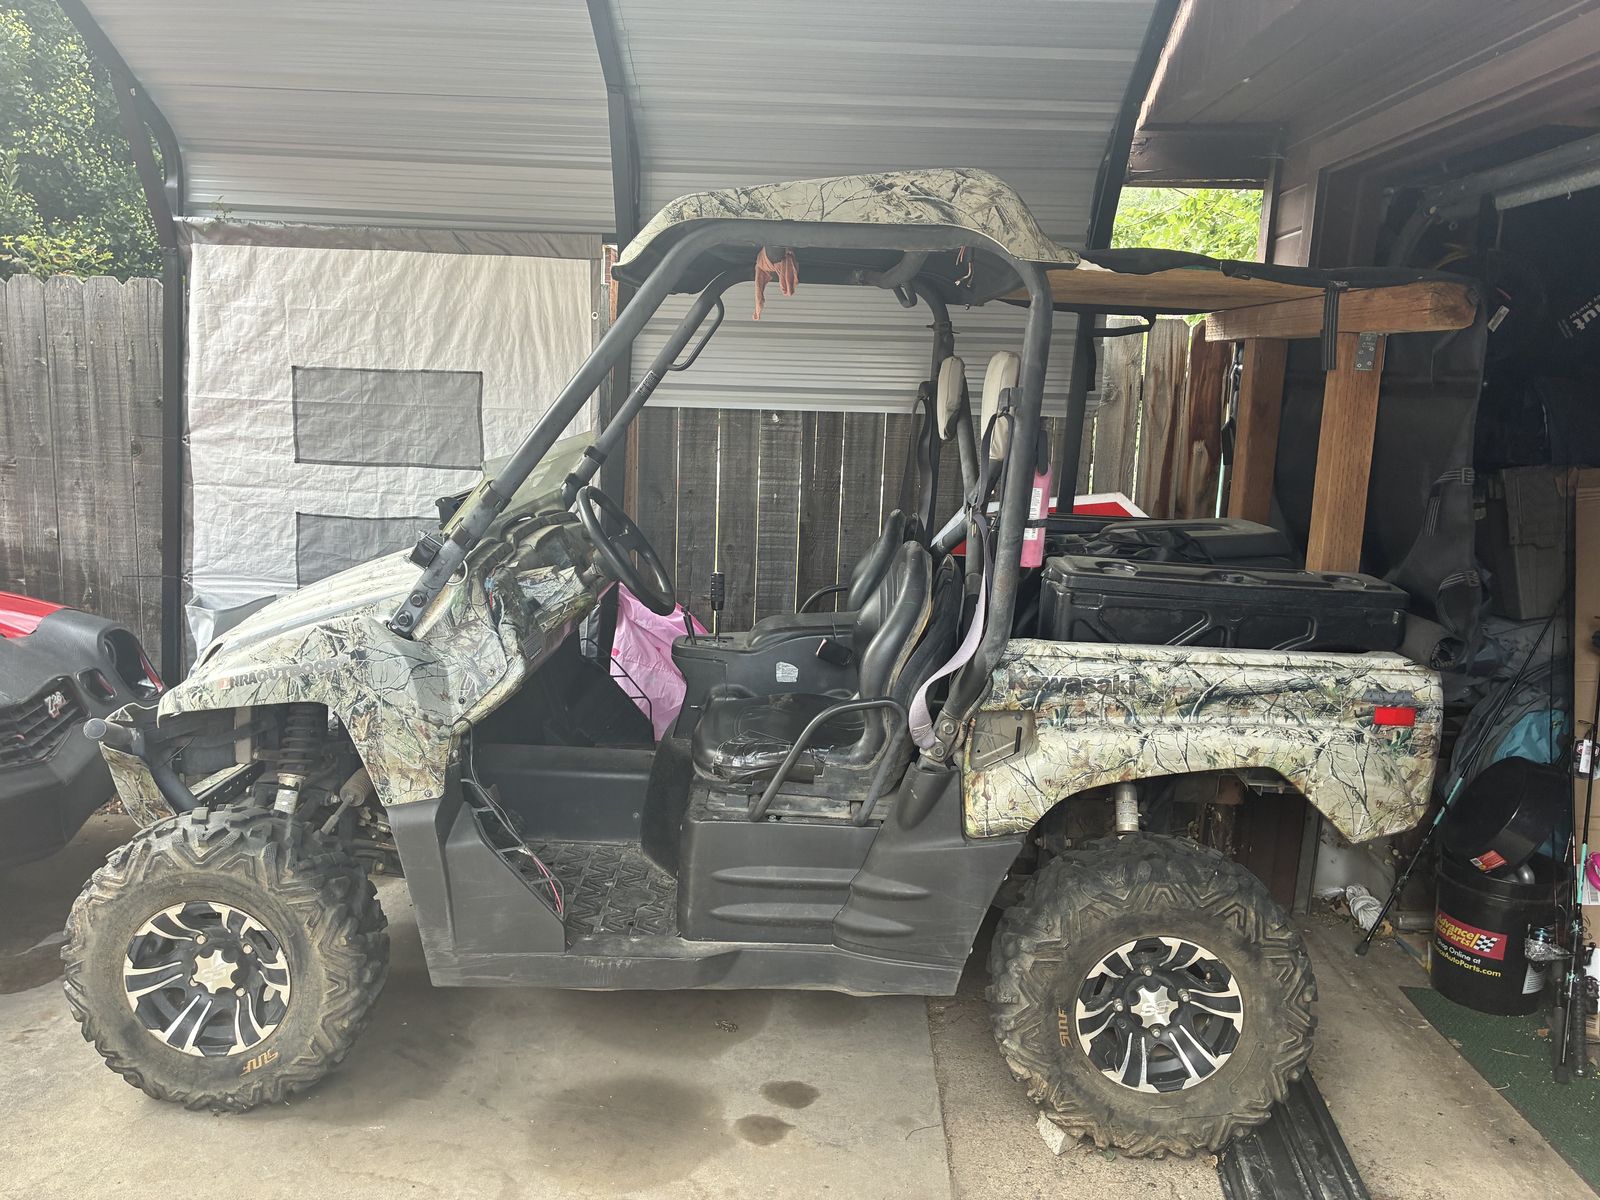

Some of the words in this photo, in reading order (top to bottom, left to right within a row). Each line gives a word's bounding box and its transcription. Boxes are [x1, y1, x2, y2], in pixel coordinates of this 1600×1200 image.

[1008, 669, 1136, 695] Kawasaki
[1435, 913, 1475, 940] Advance
[1446, 929, 1472, 946] Parts
[1448, 946, 1472, 961] Online
